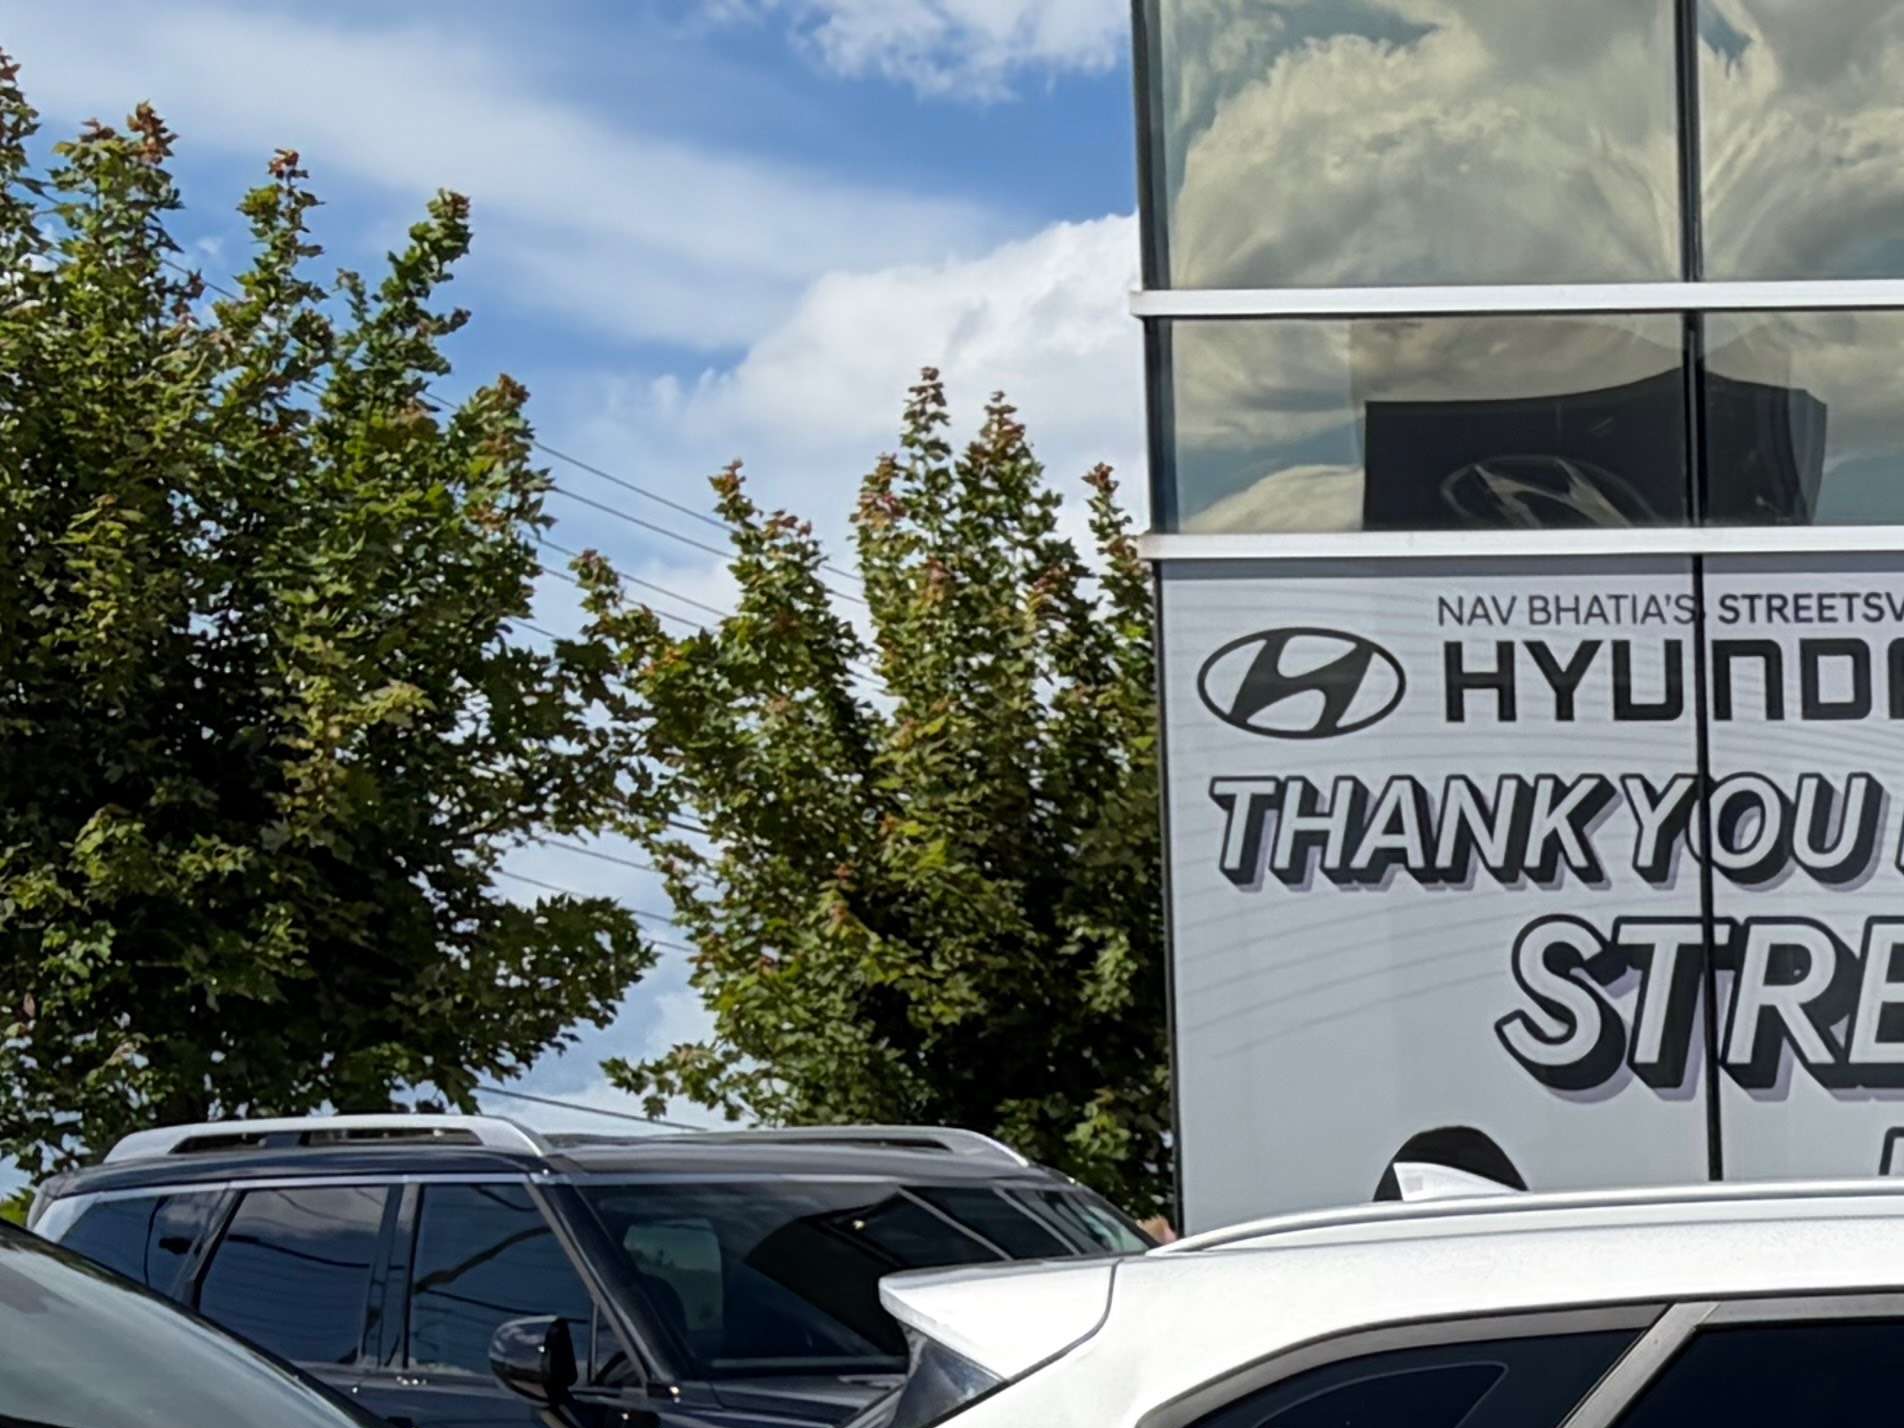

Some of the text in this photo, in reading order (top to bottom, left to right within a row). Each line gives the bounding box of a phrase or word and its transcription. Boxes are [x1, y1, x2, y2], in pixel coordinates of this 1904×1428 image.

[1437, 594, 1517, 626] NAV
[1528, 593, 1704, 626] BHATIA'S
[1209, 773, 1618, 888] THANK
[1620, 771, 1888, 890] YOU
